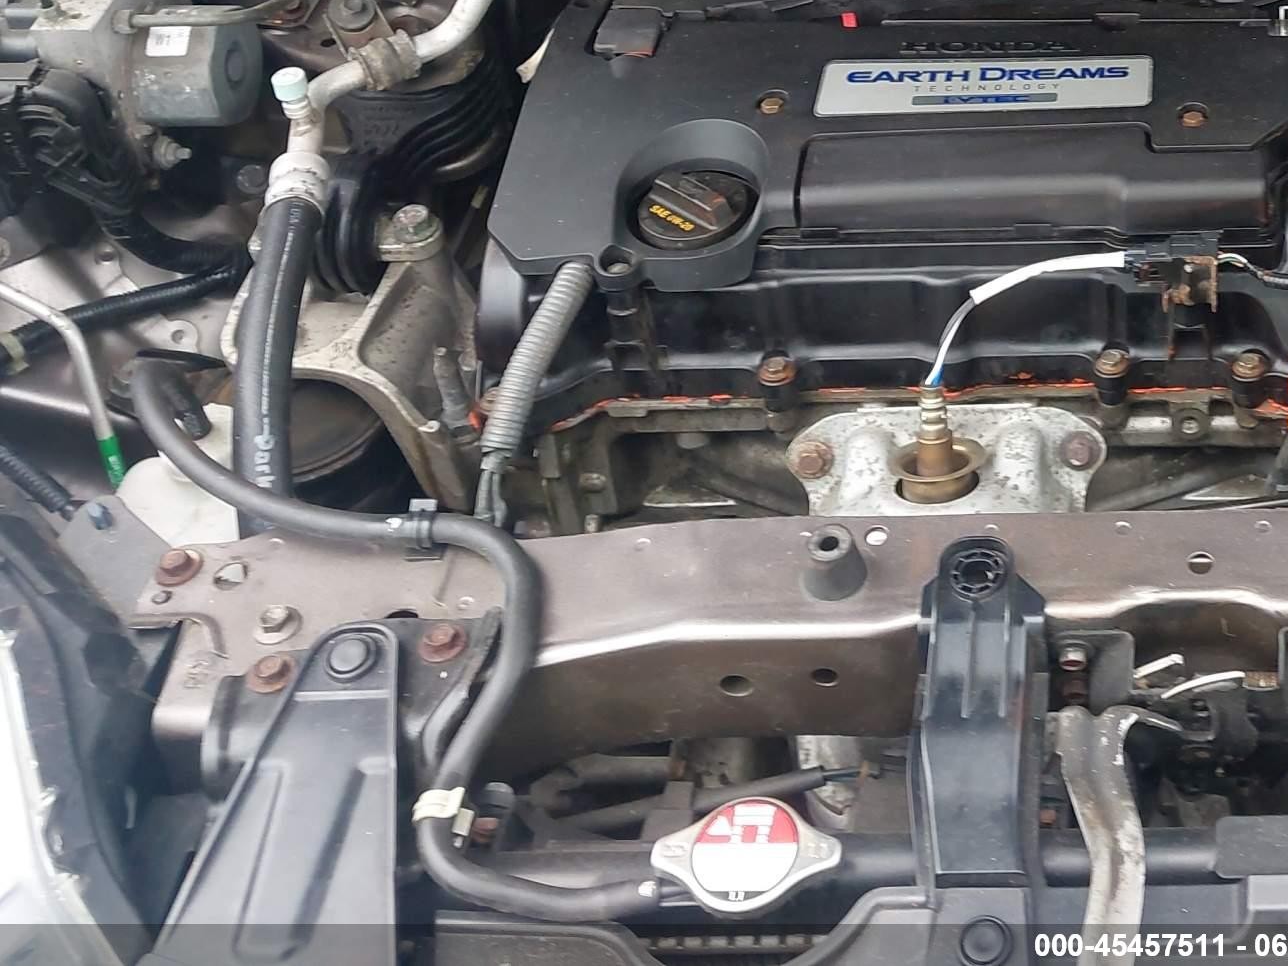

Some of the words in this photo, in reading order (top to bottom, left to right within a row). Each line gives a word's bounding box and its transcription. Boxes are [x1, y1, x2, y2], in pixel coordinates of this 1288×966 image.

[900, 41, 1079, 54] HONDA
[846, 70, 971, 84] EARTH
[979, 66, 1129, 81] DREAMS
[913, 82, 1060, 93] TECHNOLOGY
[648, 204, 671, 220] SAE
